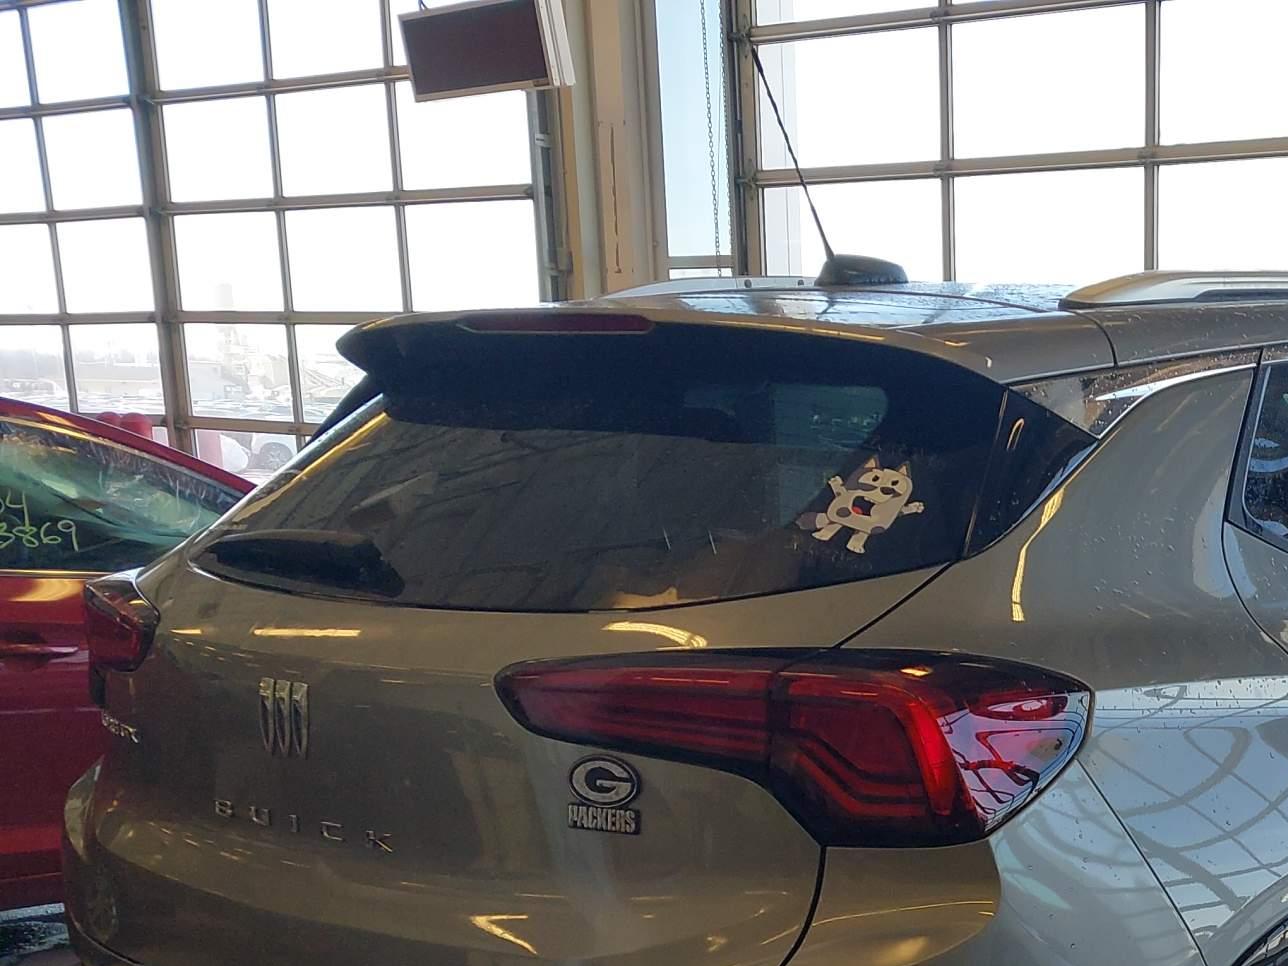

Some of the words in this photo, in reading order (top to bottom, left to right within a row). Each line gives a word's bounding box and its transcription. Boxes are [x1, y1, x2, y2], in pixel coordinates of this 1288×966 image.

[572, 760, 632, 803] G
[215, 800, 393, 853] BUICK
[568, 804, 636, 833] PACKERS
